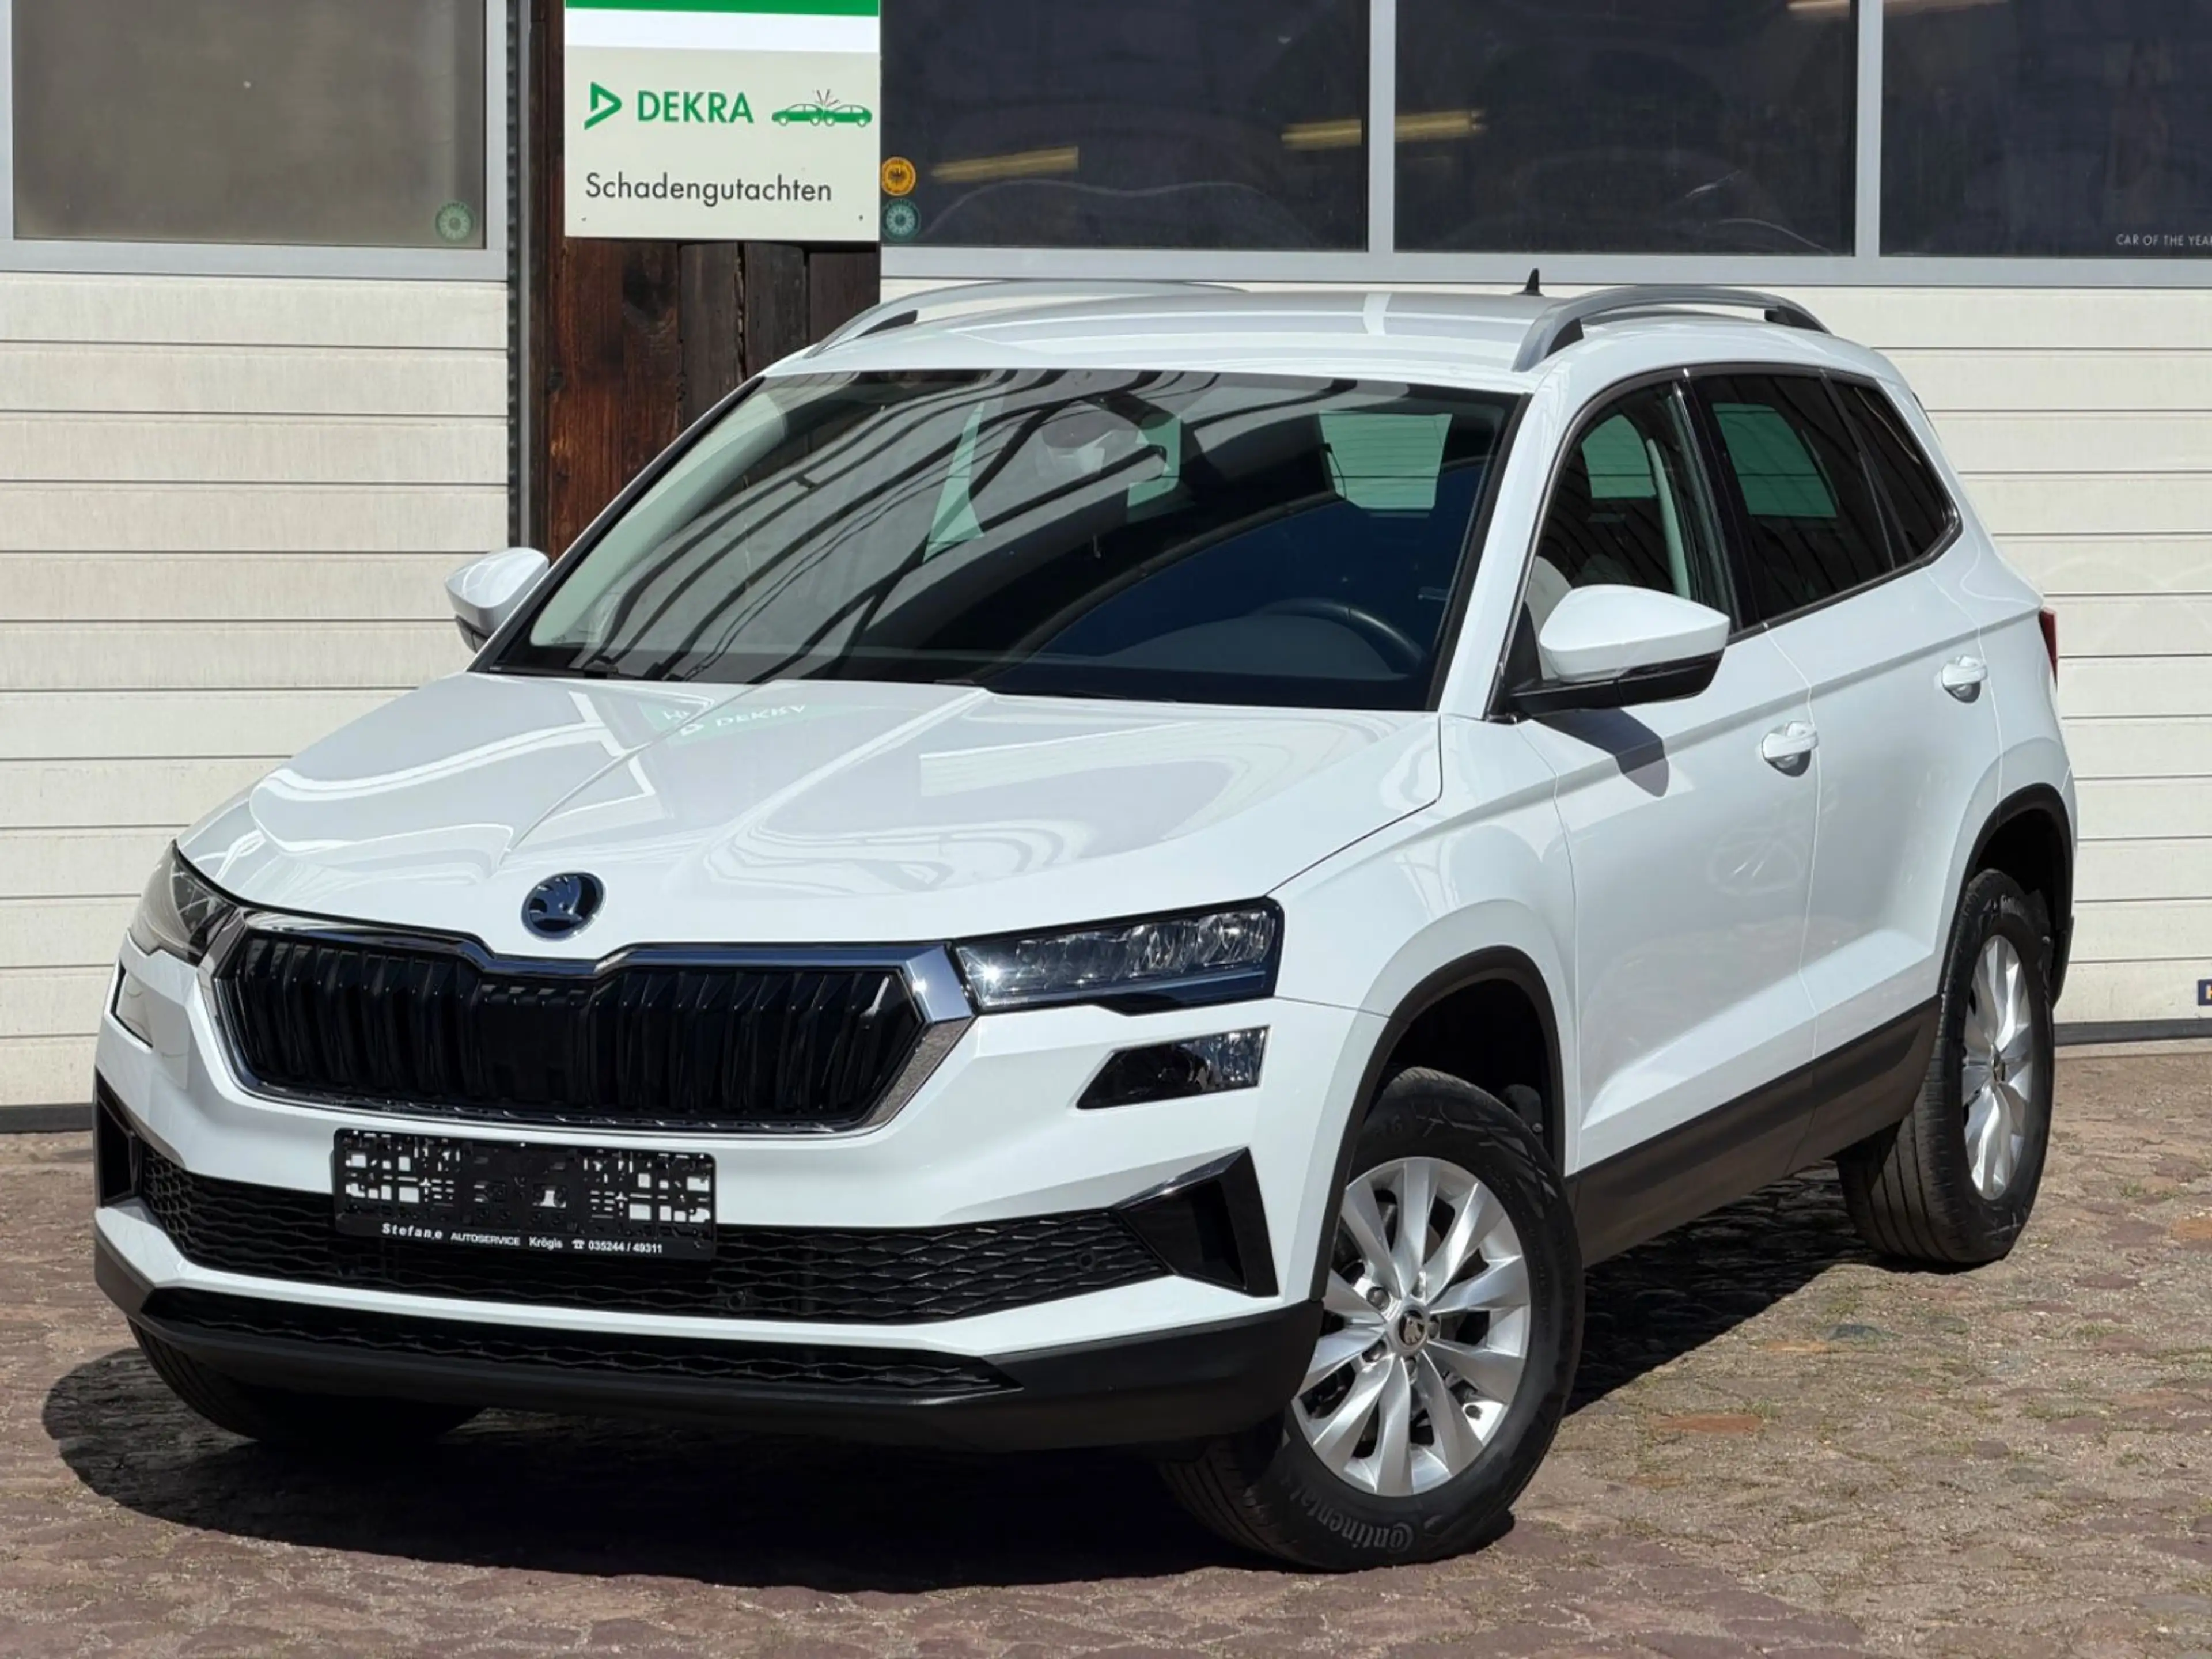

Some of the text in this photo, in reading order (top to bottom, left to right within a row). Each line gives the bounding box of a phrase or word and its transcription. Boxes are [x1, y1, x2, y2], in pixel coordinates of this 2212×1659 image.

[637, 90, 755, 124] DEKRA
[585, 171, 832, 208] Schadengutachten
[2116, 233, 2139, 246] CAR
[2142, 234, 2160, 247] OF
[2164, 234, 2184, 247] THE
[450, 1232, 521, 1247] AUTOSERVICE
[588, 1239, 625, 1252] 035244
[1289, 1485, 1415, 1554] Continental
